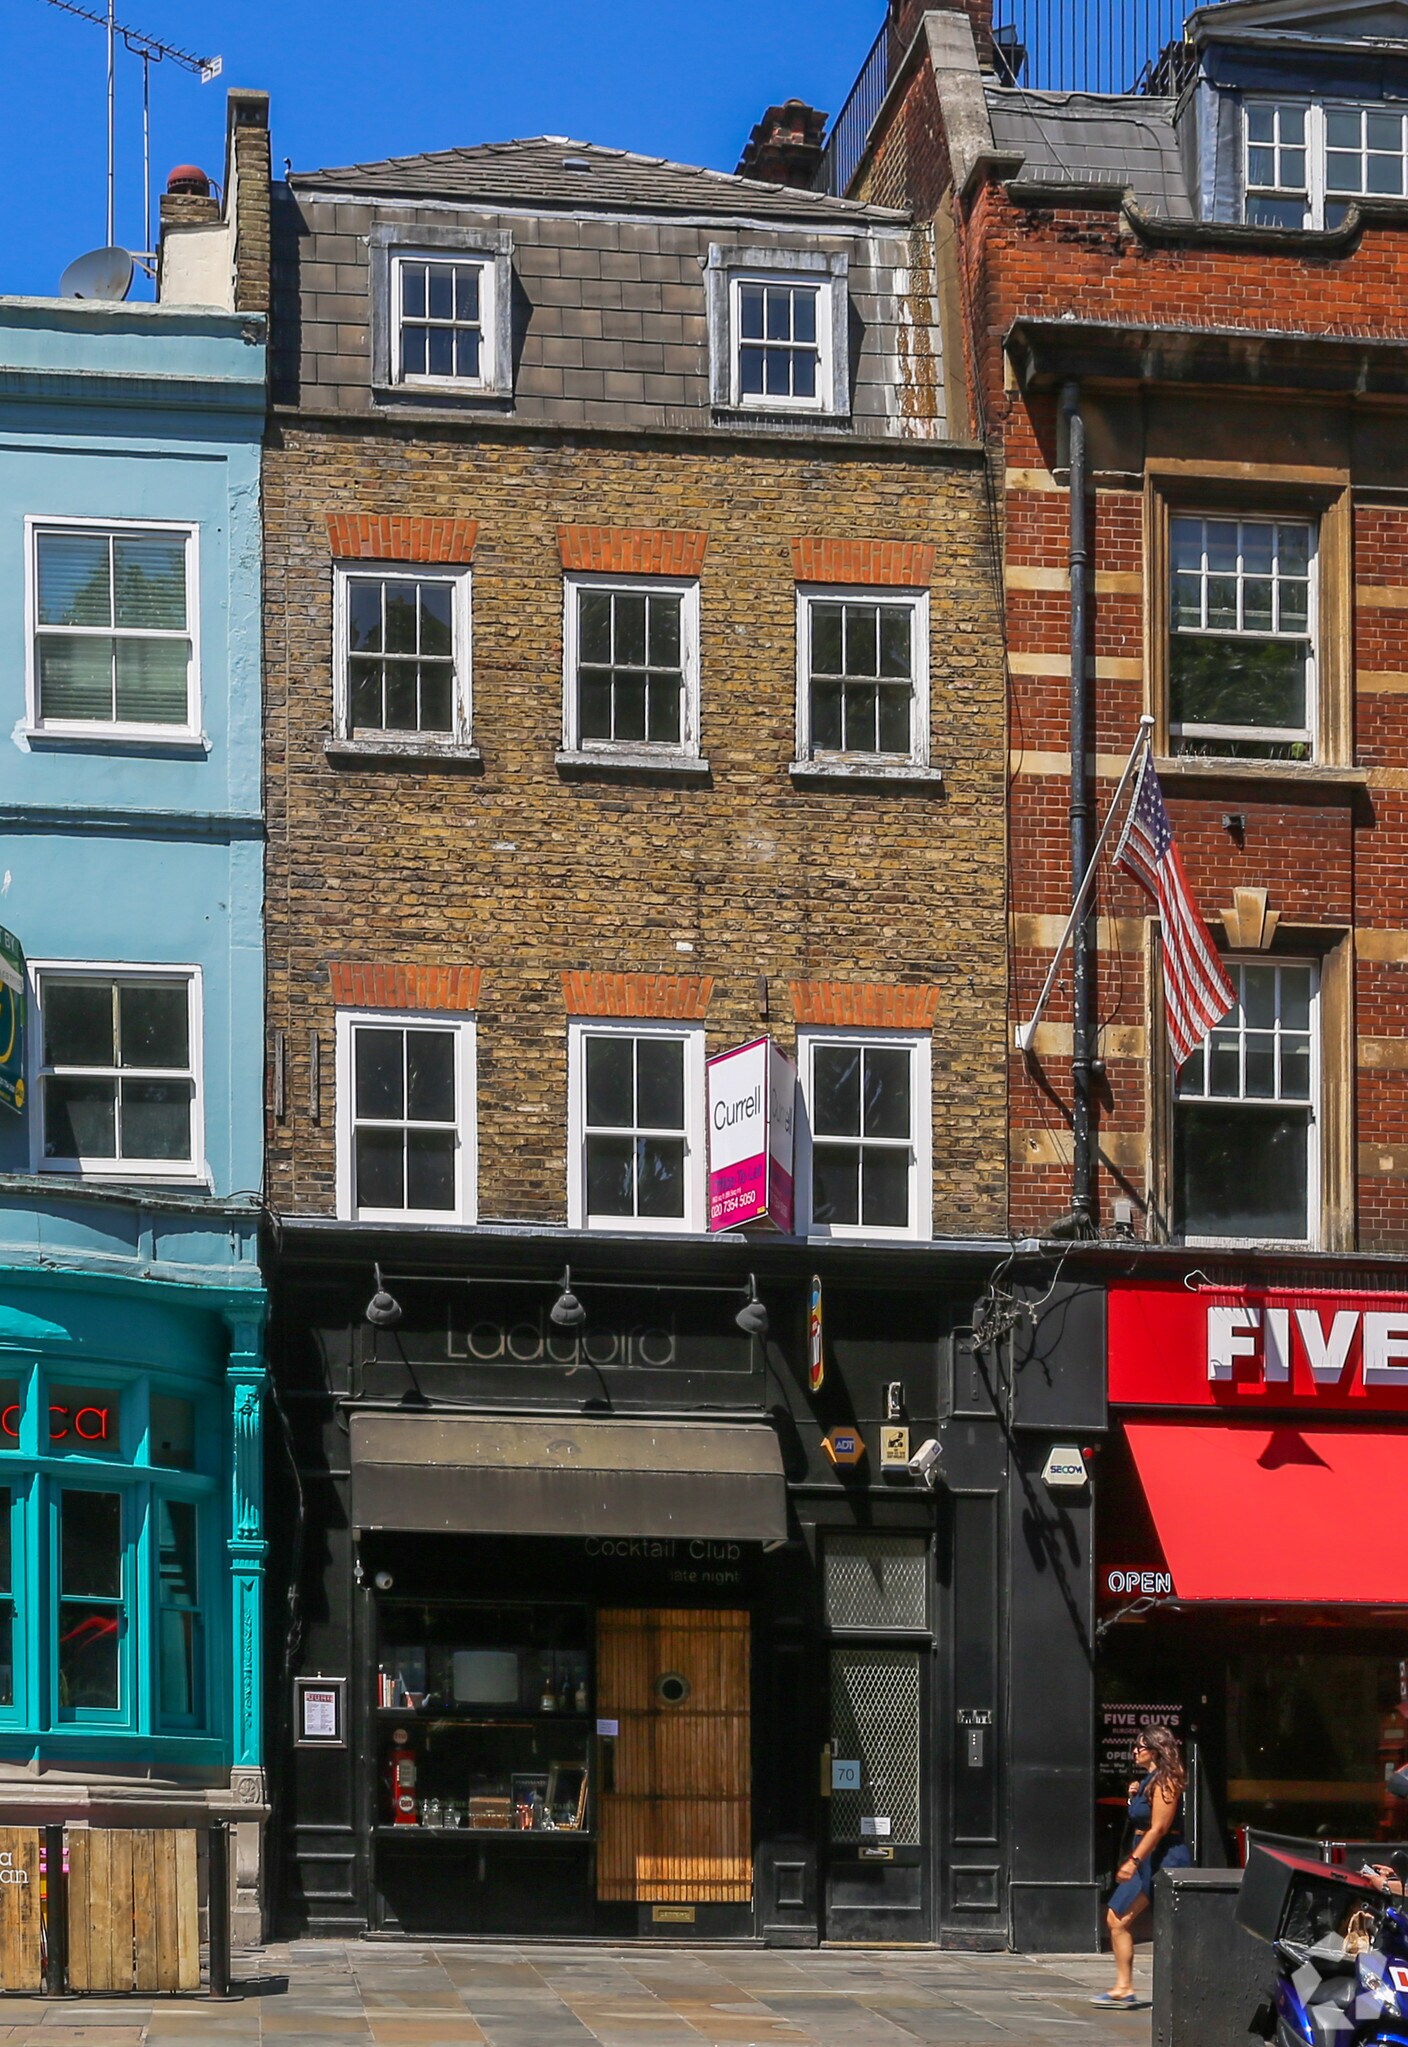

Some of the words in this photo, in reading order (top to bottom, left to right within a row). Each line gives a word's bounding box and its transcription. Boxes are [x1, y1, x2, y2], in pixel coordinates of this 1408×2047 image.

[714, 1085, 760, 1130] Currell
[711, 1203, 722, 1219] 020
[447, 1302, 675, 1376] Ladybird
[1207, 1306, 1408, 1386] FIVE
[836, 1440, 854, 1451] ADT
[1050, 1465, 1083, 1475] SECOM
[585, 1536, 675, 1558] Cocktail
[689, 1539, 740, 1560] Club
[671, 1569, 698, 1583] late
[701, 1569, 739, 1586] night
[1108, 1571, 1171, 1593] OPEN
[1104, 1713, 1136, 1725] FIVE
[1140, 1714, 1180, 1726] GUYS
[1106, 1751, 1135, 1760] OPEN
[838, 1769, 855, 1781] 70
